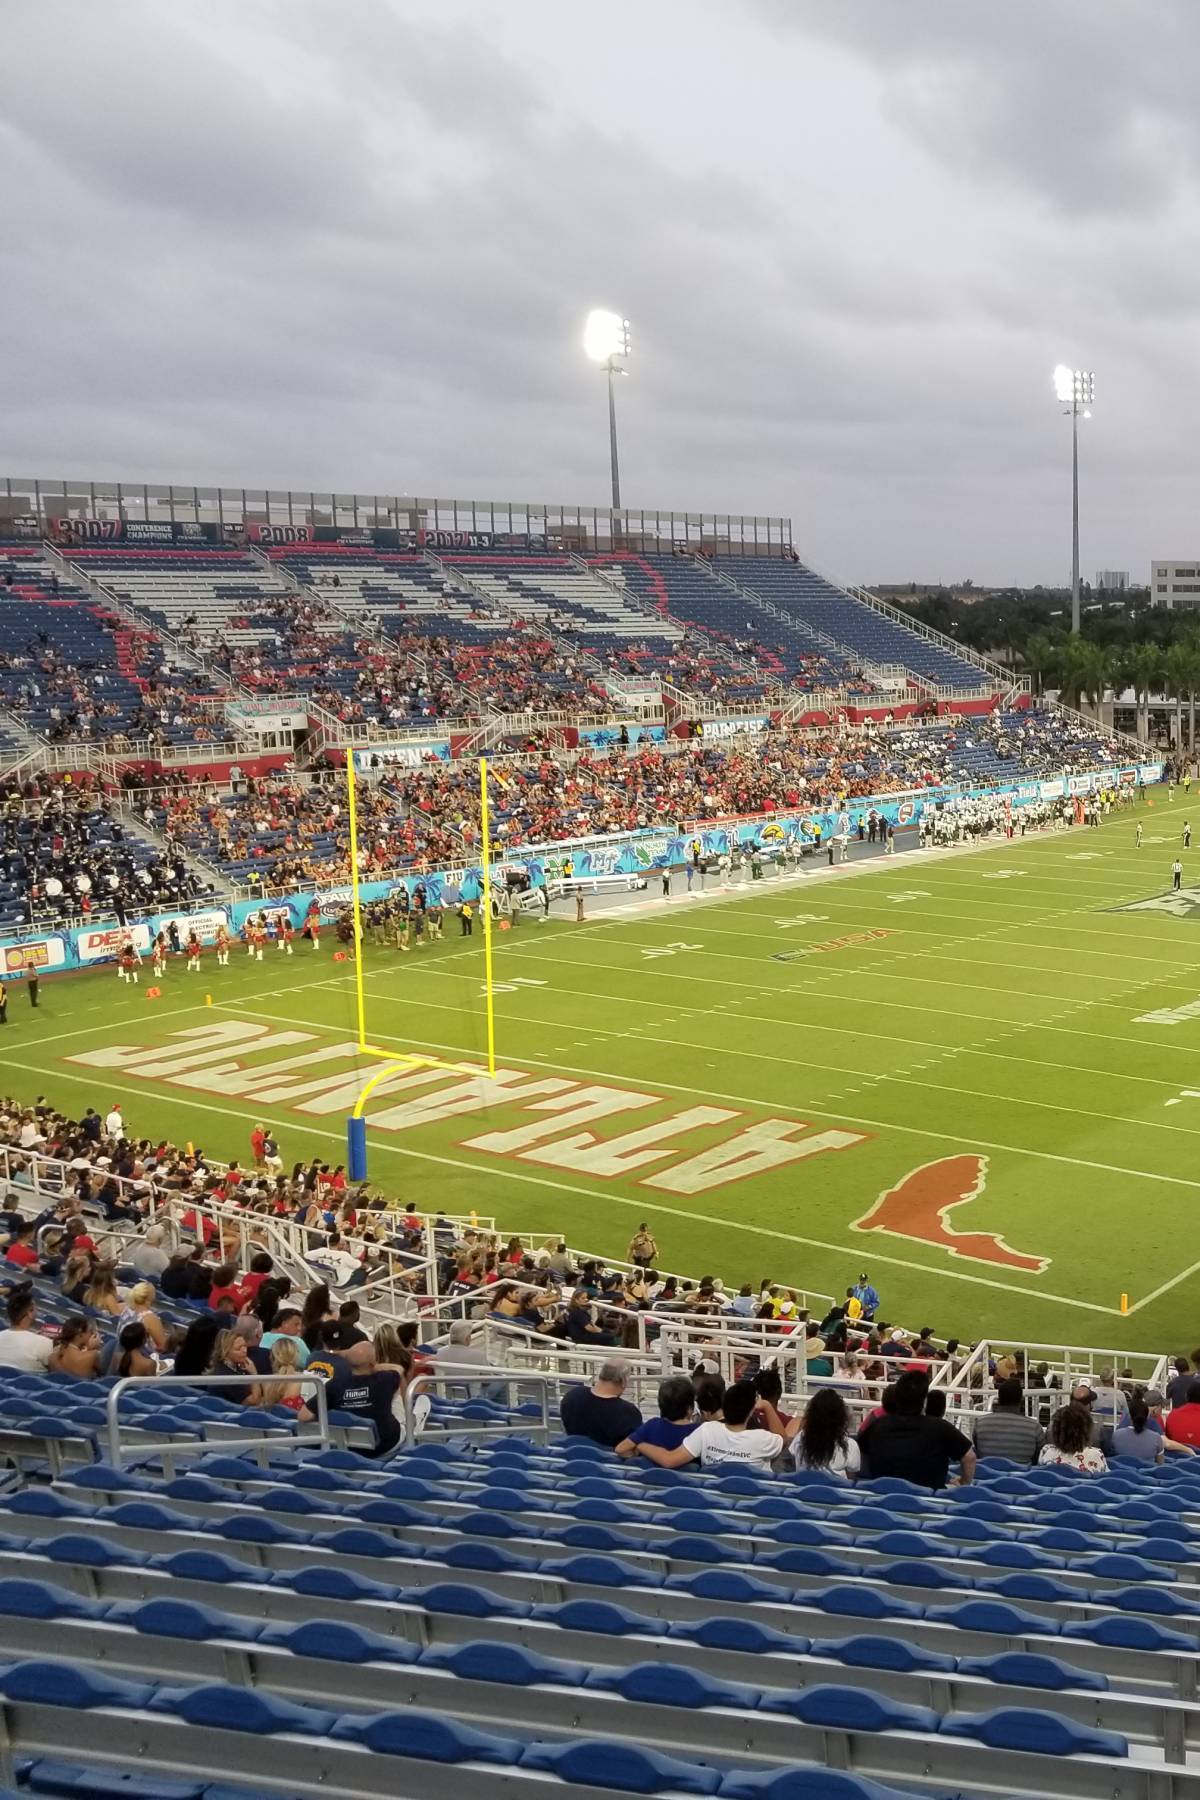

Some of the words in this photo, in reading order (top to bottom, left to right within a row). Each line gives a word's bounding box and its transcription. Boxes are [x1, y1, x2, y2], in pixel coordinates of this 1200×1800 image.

[127, 523, 173, 532] CONFERENCE
[127, 532, 173, 540] CHAMPIONS
[258, 525, 309, 542] 2008
[423, 531, 468, 546] 2017
[468, 532, 490, 547] 11-3
[446, 872, 464, 883] FIU
